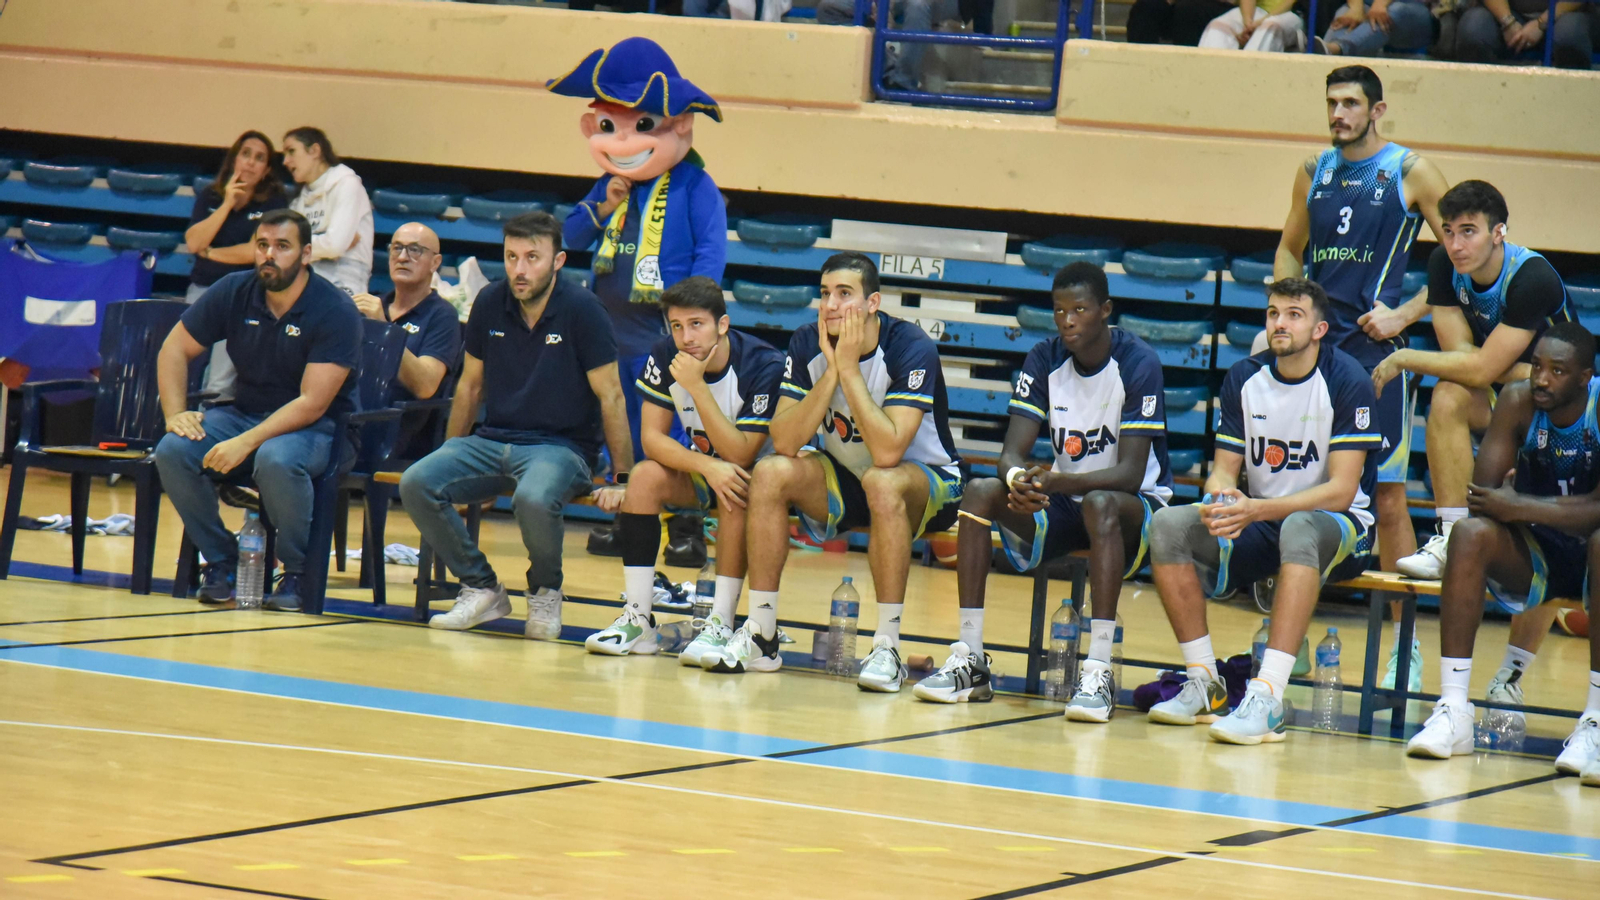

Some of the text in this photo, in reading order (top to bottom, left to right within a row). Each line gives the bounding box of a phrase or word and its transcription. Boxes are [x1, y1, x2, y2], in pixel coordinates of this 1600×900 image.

[1336, 206, 1353, 234] 3
[882, 254, 942, 276] FILA 5
[929, 321, 942, 338] 4
[1051, 424, 1117, 462] UDEA
[1250, 436, 1320, 474] UDEA
